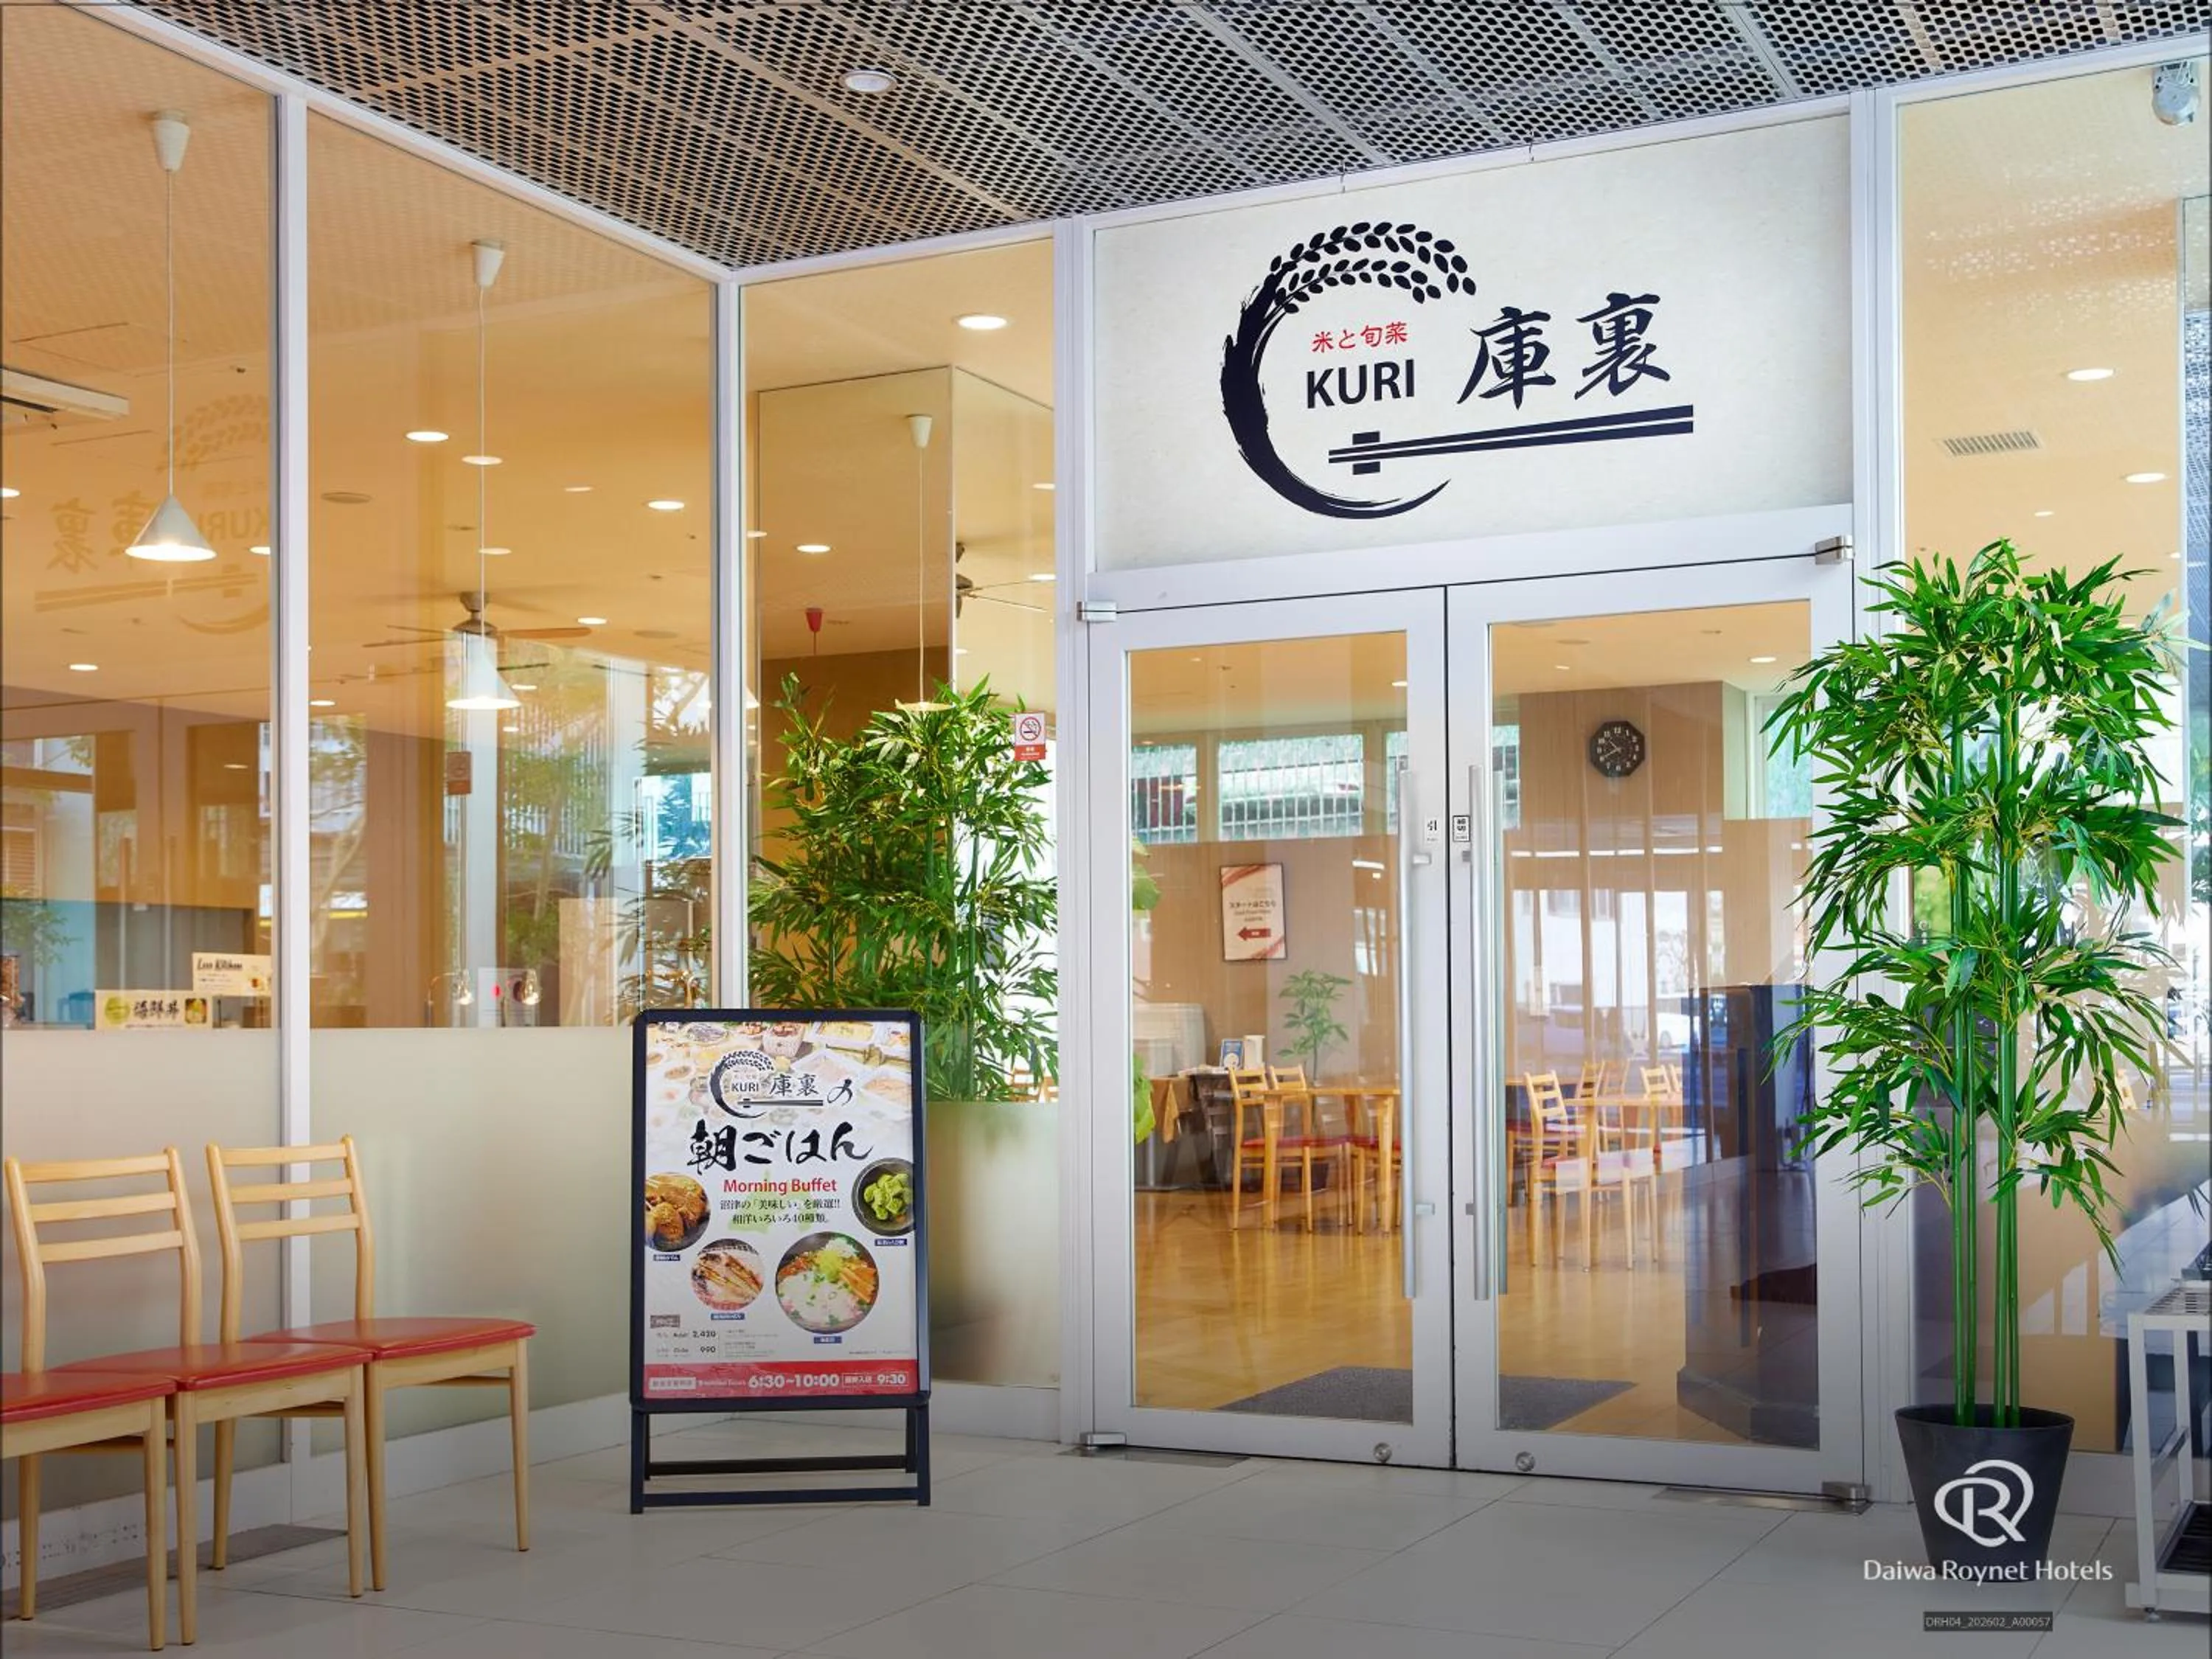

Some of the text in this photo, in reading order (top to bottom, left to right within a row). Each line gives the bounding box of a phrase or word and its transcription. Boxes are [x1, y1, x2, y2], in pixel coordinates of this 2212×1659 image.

[1312, 321, 1409, 354] 米と旬菜
[1456, 292, 1671, 411] 庫裏
[1306, 359, 1416, 408] KURI
[731, 1082, 759, 1092] KURI
[686, 1119, 874, 1175] 朝ごはん
[723, 1178, 837, 1195] Morning Buffet
[877, 1374, 906, 1385] 9:30
